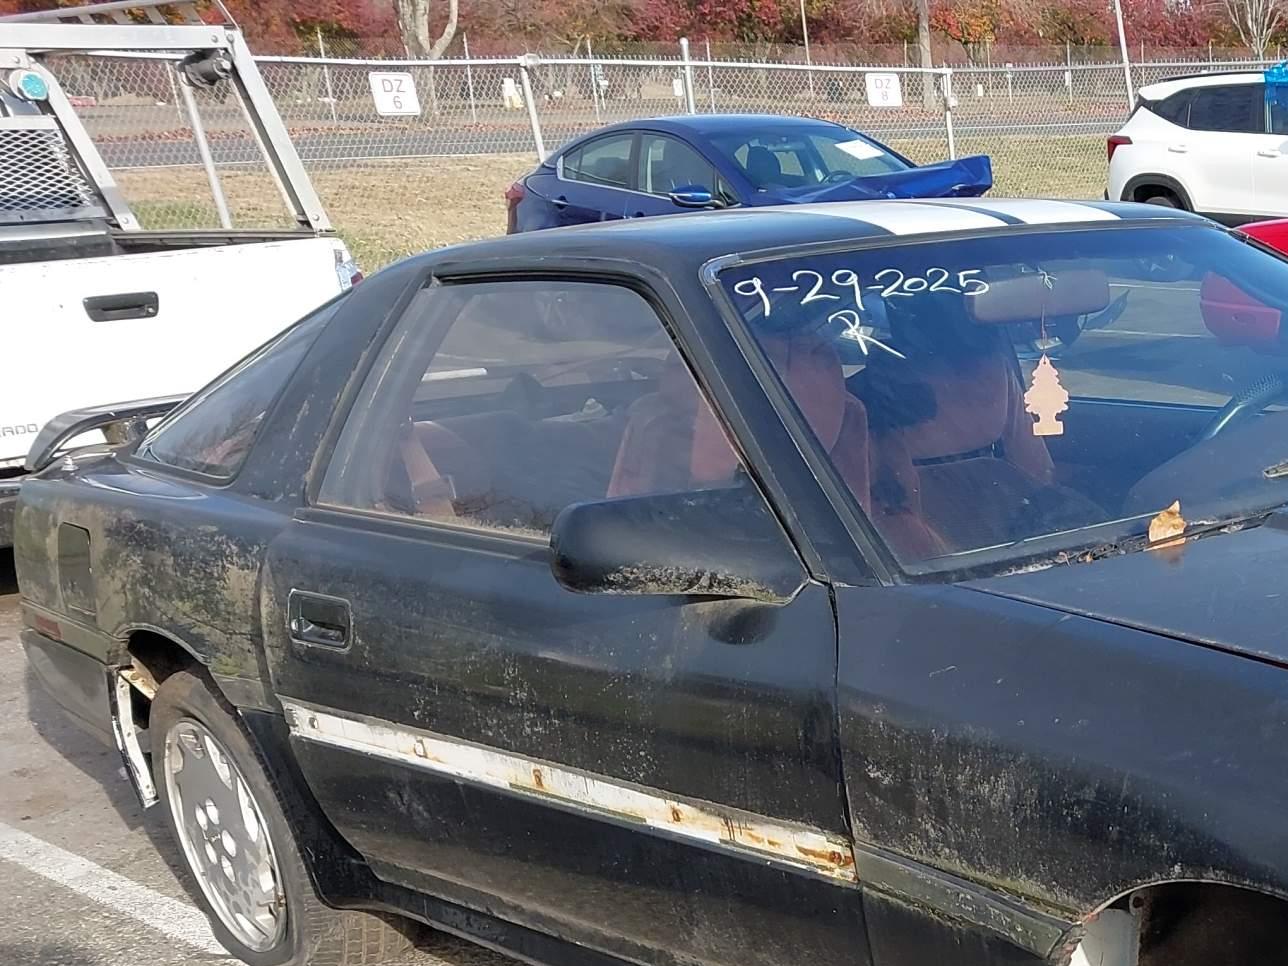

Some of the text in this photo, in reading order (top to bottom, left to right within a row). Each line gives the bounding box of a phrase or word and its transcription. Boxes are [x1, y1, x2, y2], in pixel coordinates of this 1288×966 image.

[381, 78, 406, 93] DZ
[874, 78, 892, 89] DZ
[393, 95, 403, 110] 6
[881, 90, 889, 102] 8
[734, 267, 991, 317] 9-29-2025
[0, 423, 39, 437] ADO
